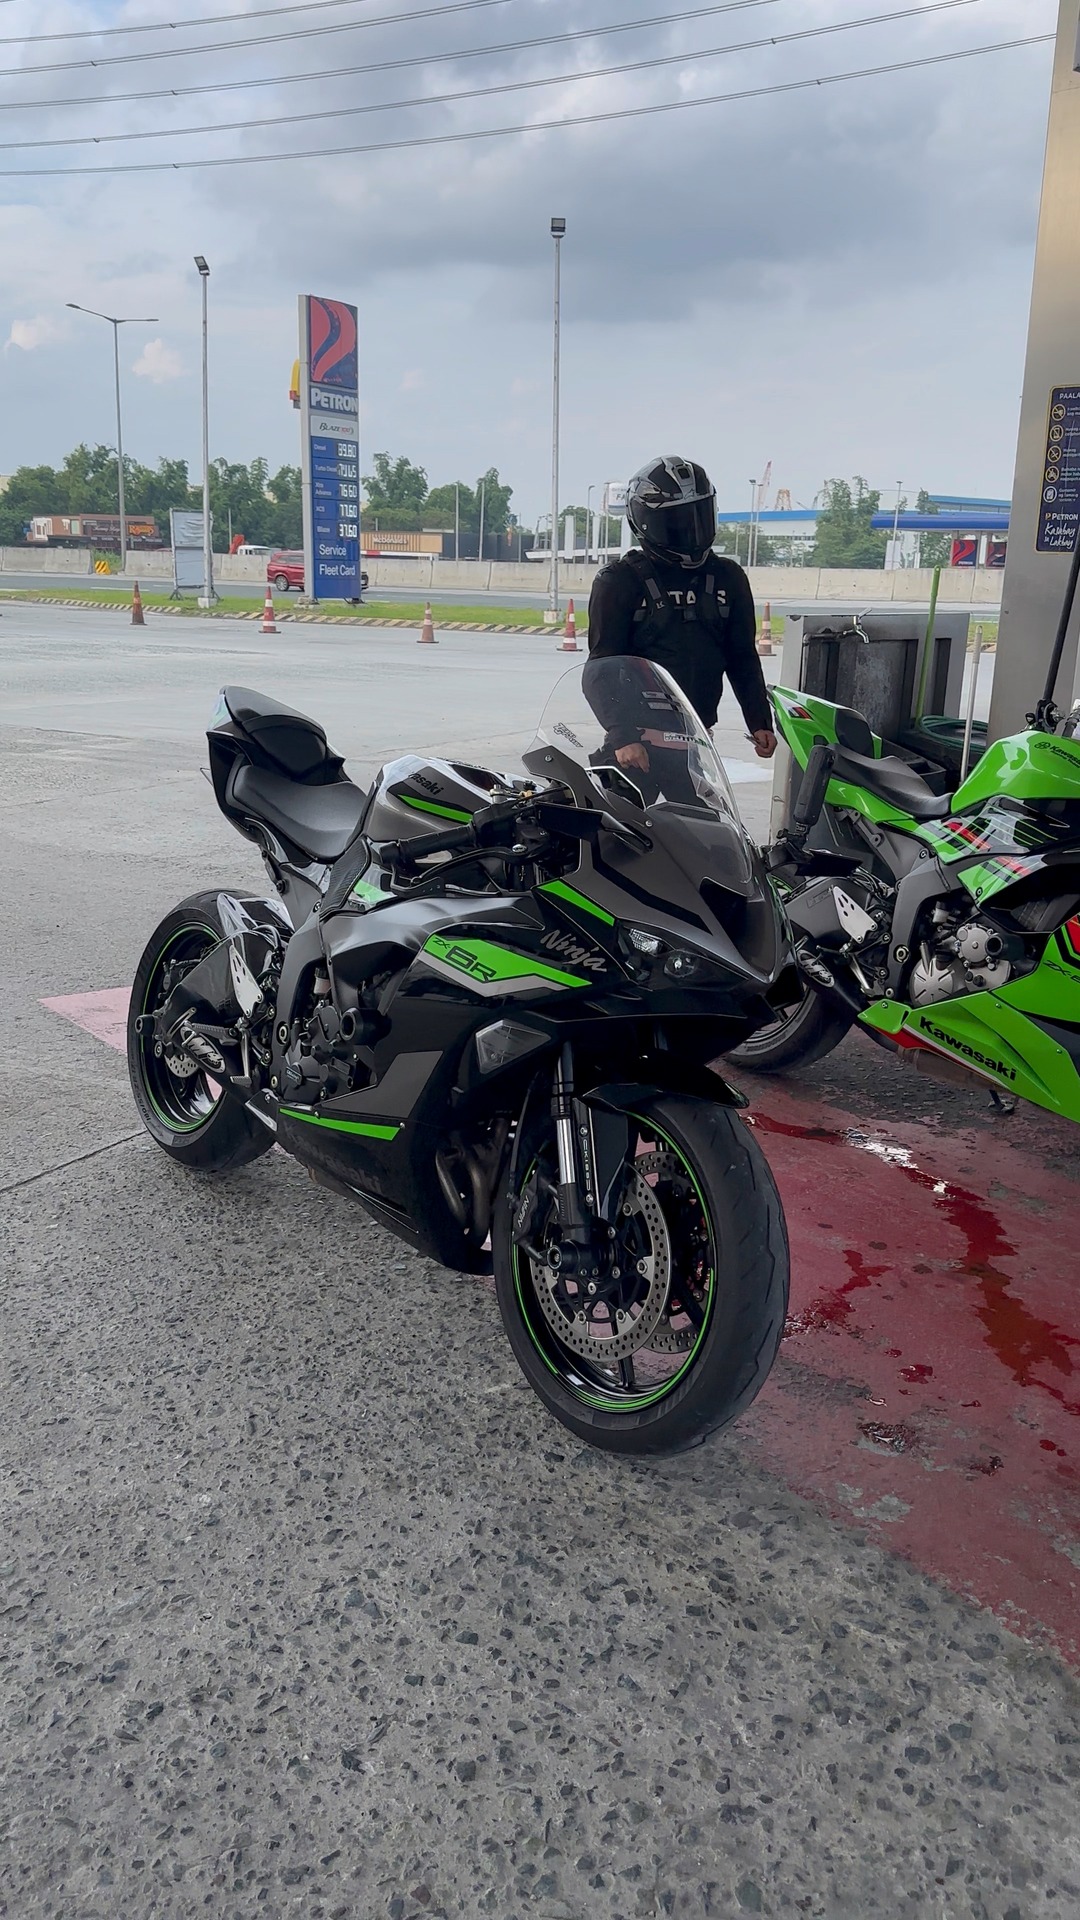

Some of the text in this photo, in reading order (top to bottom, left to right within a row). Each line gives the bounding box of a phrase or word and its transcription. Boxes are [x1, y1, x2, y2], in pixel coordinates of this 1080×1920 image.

[310, 387, 358, 412] PETRON
[1051, 512, 1079, 520] PETRON
[1044, 522, 1076, 537] Kasabay
[319, 543, 347, 556] Service
[1050, 535, 1074, 549] Lakbay
[319, 563, 356, 576] Fleet Card
[408, 771, 445, 795] asaki
[540, 929, 608, 972] Ninja
[919, 1015, 1017, 1081] Kawasaki
